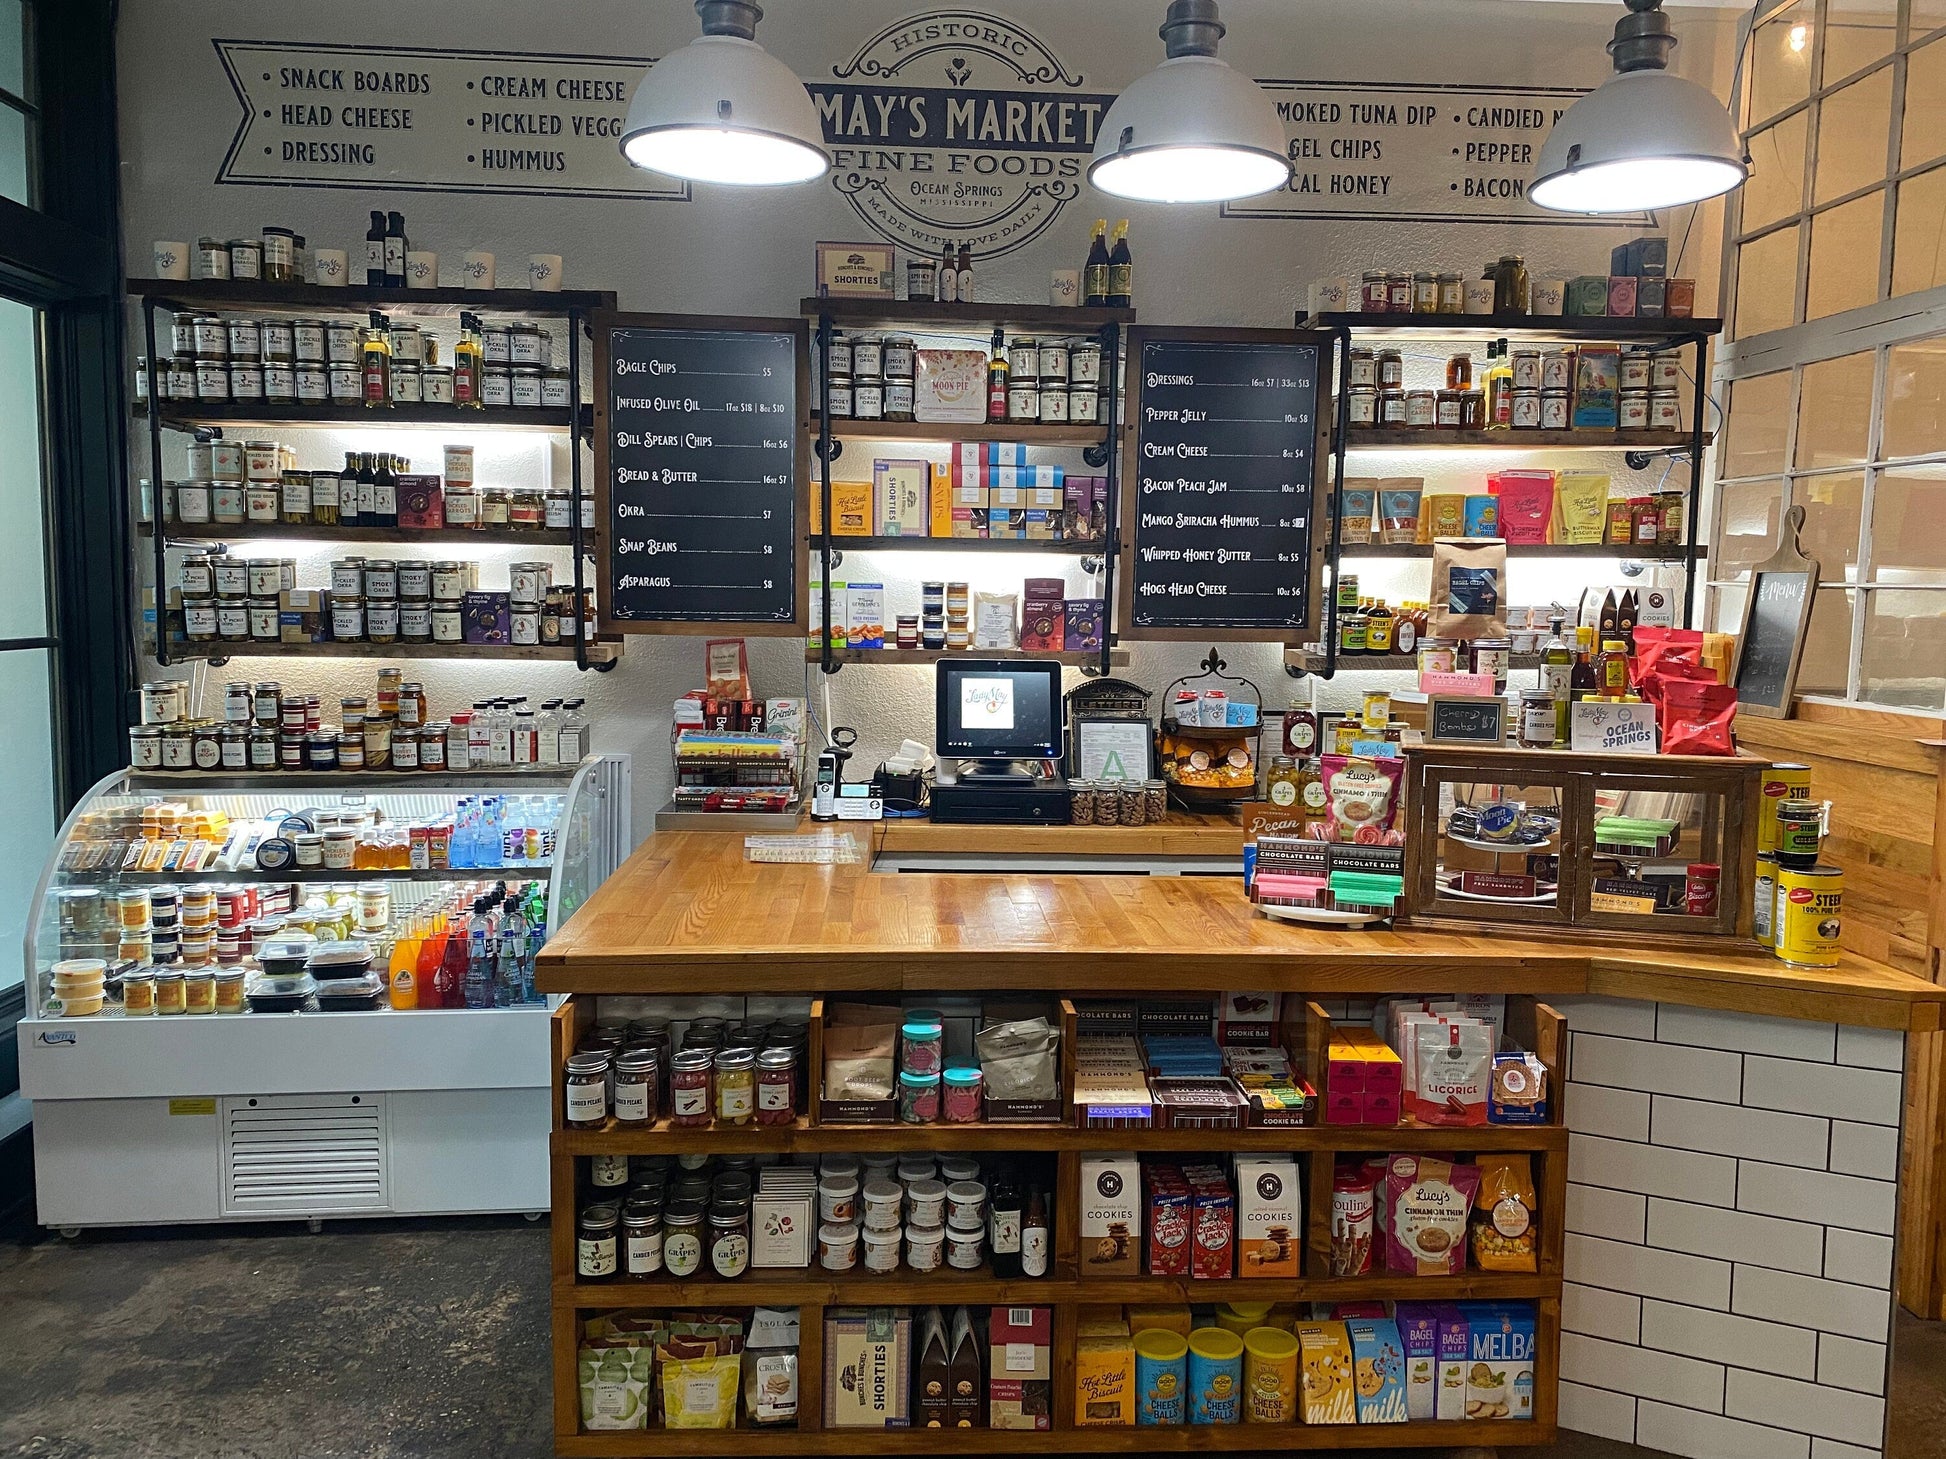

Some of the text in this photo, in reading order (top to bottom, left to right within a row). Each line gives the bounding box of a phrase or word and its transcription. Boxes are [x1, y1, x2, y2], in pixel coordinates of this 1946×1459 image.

[891, 23, 1029, 55] HISTORIC
[280, 68, 431, 95] SNACK BOARDS
[481, 76, 625, 101] CREAM CHEESE
[281, 105, 412, 129] HEAD CHEESE
[812, 92, 1101, 144] MAY'S MARKET
[1273, 102, 1436, 125] MOKED TUNA DIP
[1467, 108, 1544, 128] CANDIED
[482, 112, 625, 137] PICKLED VEGG
[282, 141, 375, 164] DRESSING
[1330, 139, 1381, 159] CHIPS
[1466, 143, 1531, 163] PEPPER
[482, 149, 566, 172] HUMMUS
[832, 150, 1081, 178] FINE FOODS
[1330, 175, 1391, 194] HONEY
[1465, 178, 1523, 198] BACON
[868, 196, 906, 232] MADE
[1001, 203, 1042, 237] DAILY
[834, 276, 878, 284] SHORTIES
[762, 368, 771, 377] $5
[932, 382, 969, 390] MOON PIE
[1266, 378, 1274, 387] $7
[1298, 380, 1309, 388] $13
[741, 402, 752, 412] $18
[773, 404, 784, 413] $10
[1300, 415, 1308, 423] $8
[779, 440, 787, 449] $6
[1295, 450, 1304, 458] $4
[652, 471, 659, 481] &
[779, 475, 787, 484] $7
[1296, 484, 1304, 493] $8
[888, 477, 896, 520] SHORTIES
[763, 510, 771, 519] $7
[763, 545, 772, 554] $8
[1290, 553, 1299, 562] $5
[763, 580, 772, 588] $8
[1766, 581, 1801, 600] Menu
[1292, 588, 1300, 596] $6
[1606, 721, 1644, 737] OCEAN
[1602, 731, 1651, 748] SPRINGS
[1101, 750, 1129, 779] A
[1345, 770, 1376, 782] Lucy's
[1479, 808, 1506, 825] Moon
[1496, 813, 1514, 825] Pie
[1249, 817, 1300, 833] Pecan
[503, 830, 511, 859] hint
[1305, 853, 1325, 861] BARS
[1333, 859, 1378, 867] CHOCOLATE
[1688, 891, 1713, 901] Biscoff
[1428, 1084, 1478, 1095] LICORICE
[1415, 1188, 1451, 1205] Lucy's
[1087, 1211, 1133, 1219] COOKIES
[1247, 1213, 1293, 1221] COOKIES
[1405, 1207, 1464, 1216] CINNAMON THIN
[1154, 1220, 1188, 1233] Cracker
[1160, 1228, 1183, 1243] Jack
[759, 1320, 788, 1328] ISOLA
[1410, 1329, 1434, 1340] BAGEL
[1409, 1340, 1434, 1348] CHIPS
[1473, 1333, 1535, 1360] MELBA
[874, 1345, 886, 1411] SHORTIES
[1081, 1371, 1127, 1390] Hot Little
[1088, 1384, 1124, 1401] Biscuit
[1151, 1400, 1180, 1410] CHEESE
[1253, 1399, 1283, 1410] CHEESE
[1308, 1388, 1356, 1423] milk
[1361, 1386, 1406, 1423] milk
[1153, 1409, 1178, 1419] BALLS
[1255, 1409, 1281, 1418] BALLS
